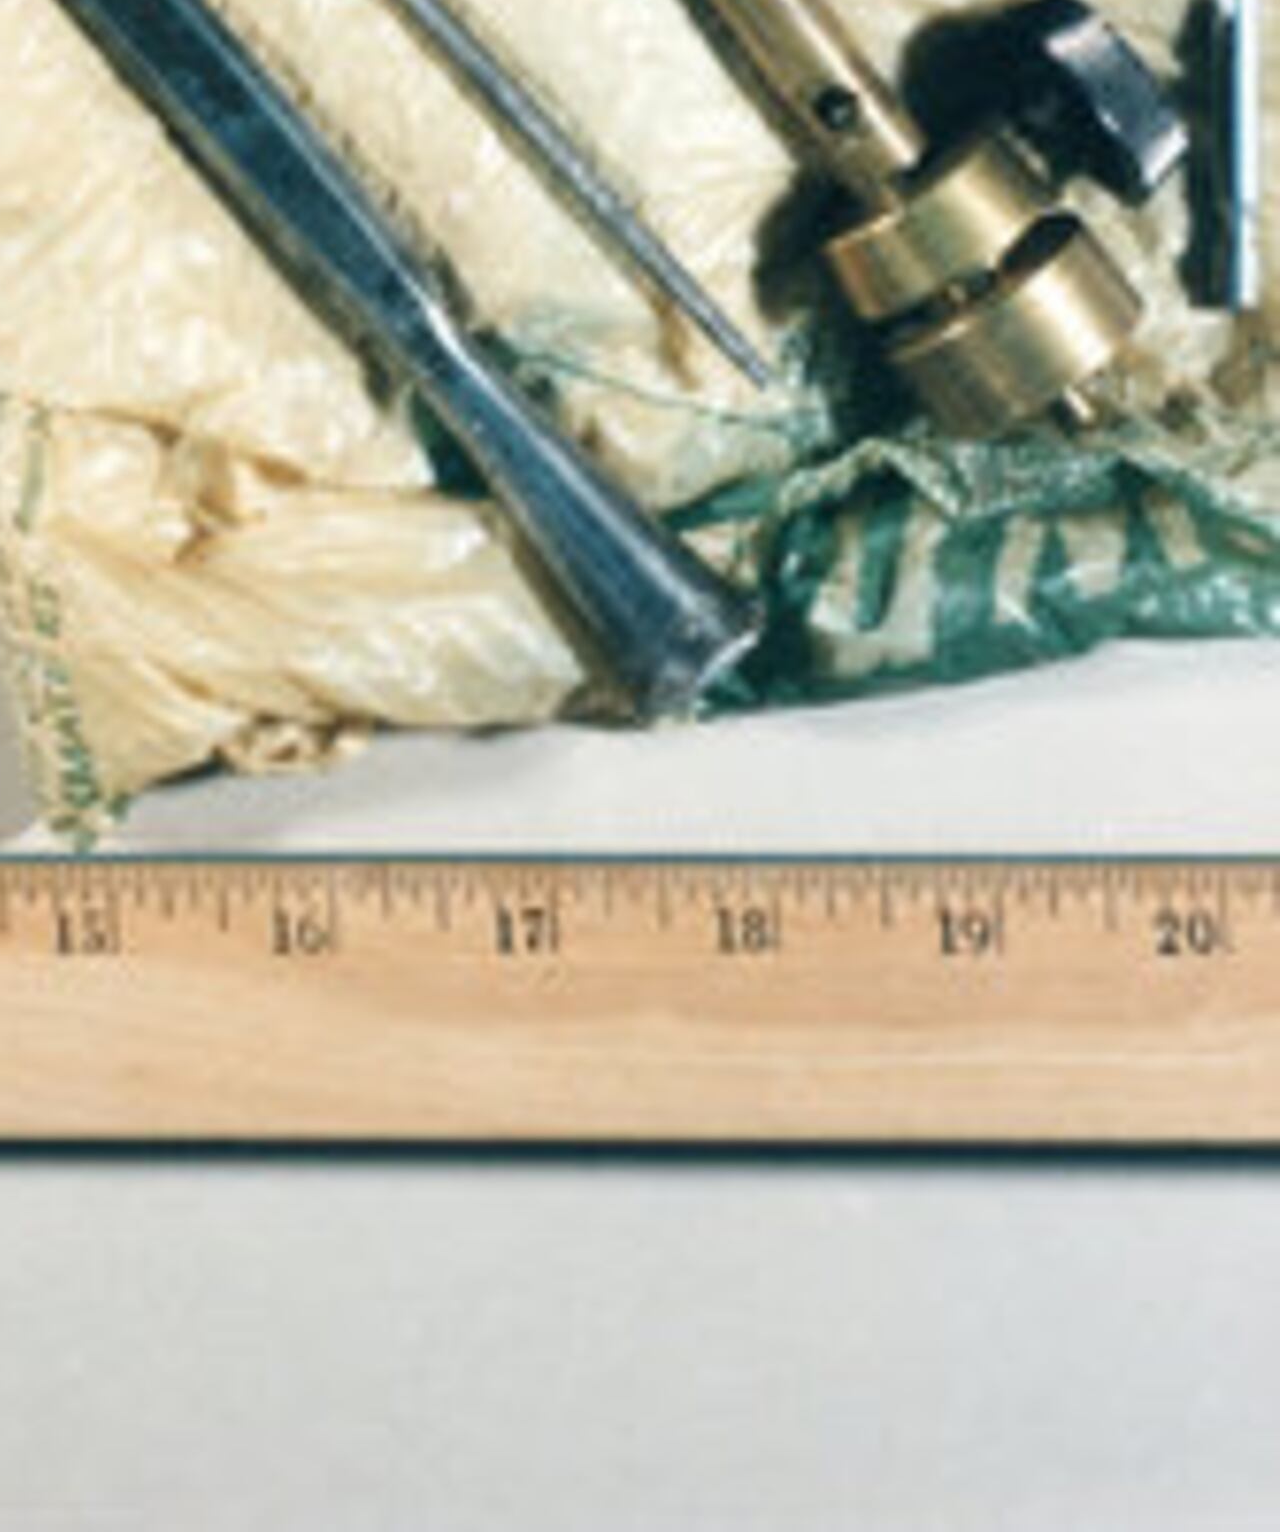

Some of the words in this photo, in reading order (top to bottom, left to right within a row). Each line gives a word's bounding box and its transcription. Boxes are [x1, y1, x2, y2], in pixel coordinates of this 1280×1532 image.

[57, 913, 107, 956] 15
[271, 907, 328, 955] 16
[496, 906, 546, 956] 17
[716, 906, 771, 955] 18
[939, 906, 993, 956] 19
[1153, 907, 1218, 956] 20
